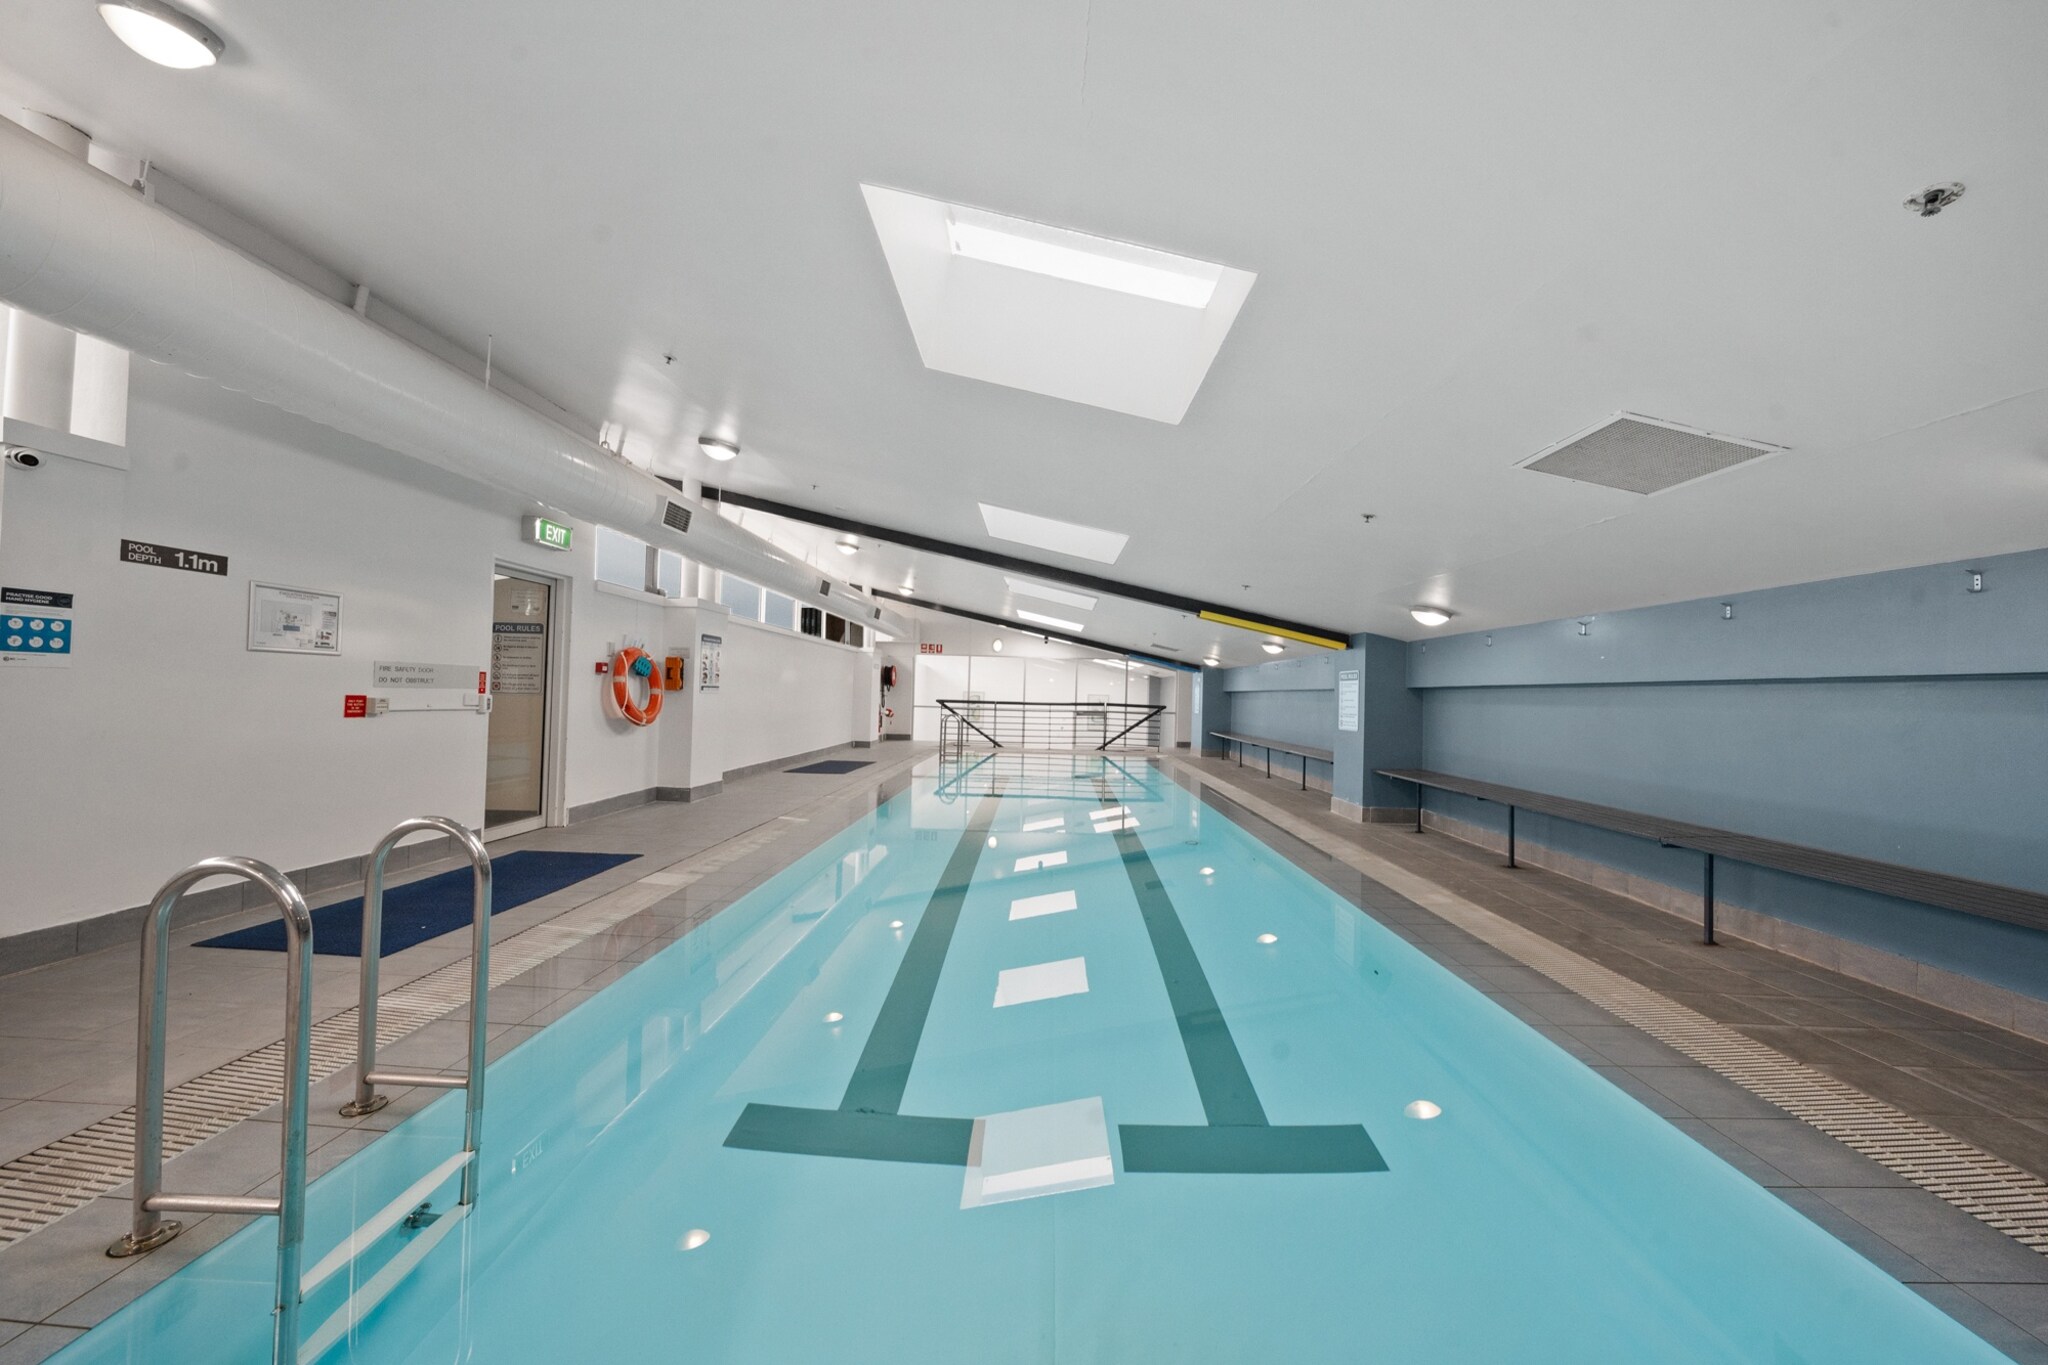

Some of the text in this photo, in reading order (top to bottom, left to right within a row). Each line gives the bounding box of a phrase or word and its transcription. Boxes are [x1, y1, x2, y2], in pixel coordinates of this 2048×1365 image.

[546, 524, 566, 545] EXIT
[128, 543, 157, 555] POOL
[128, 552, 162, 564] DEPTH
[174, 552, 218, 573] 1.1m
[495, 624, 515, 632] POOL
